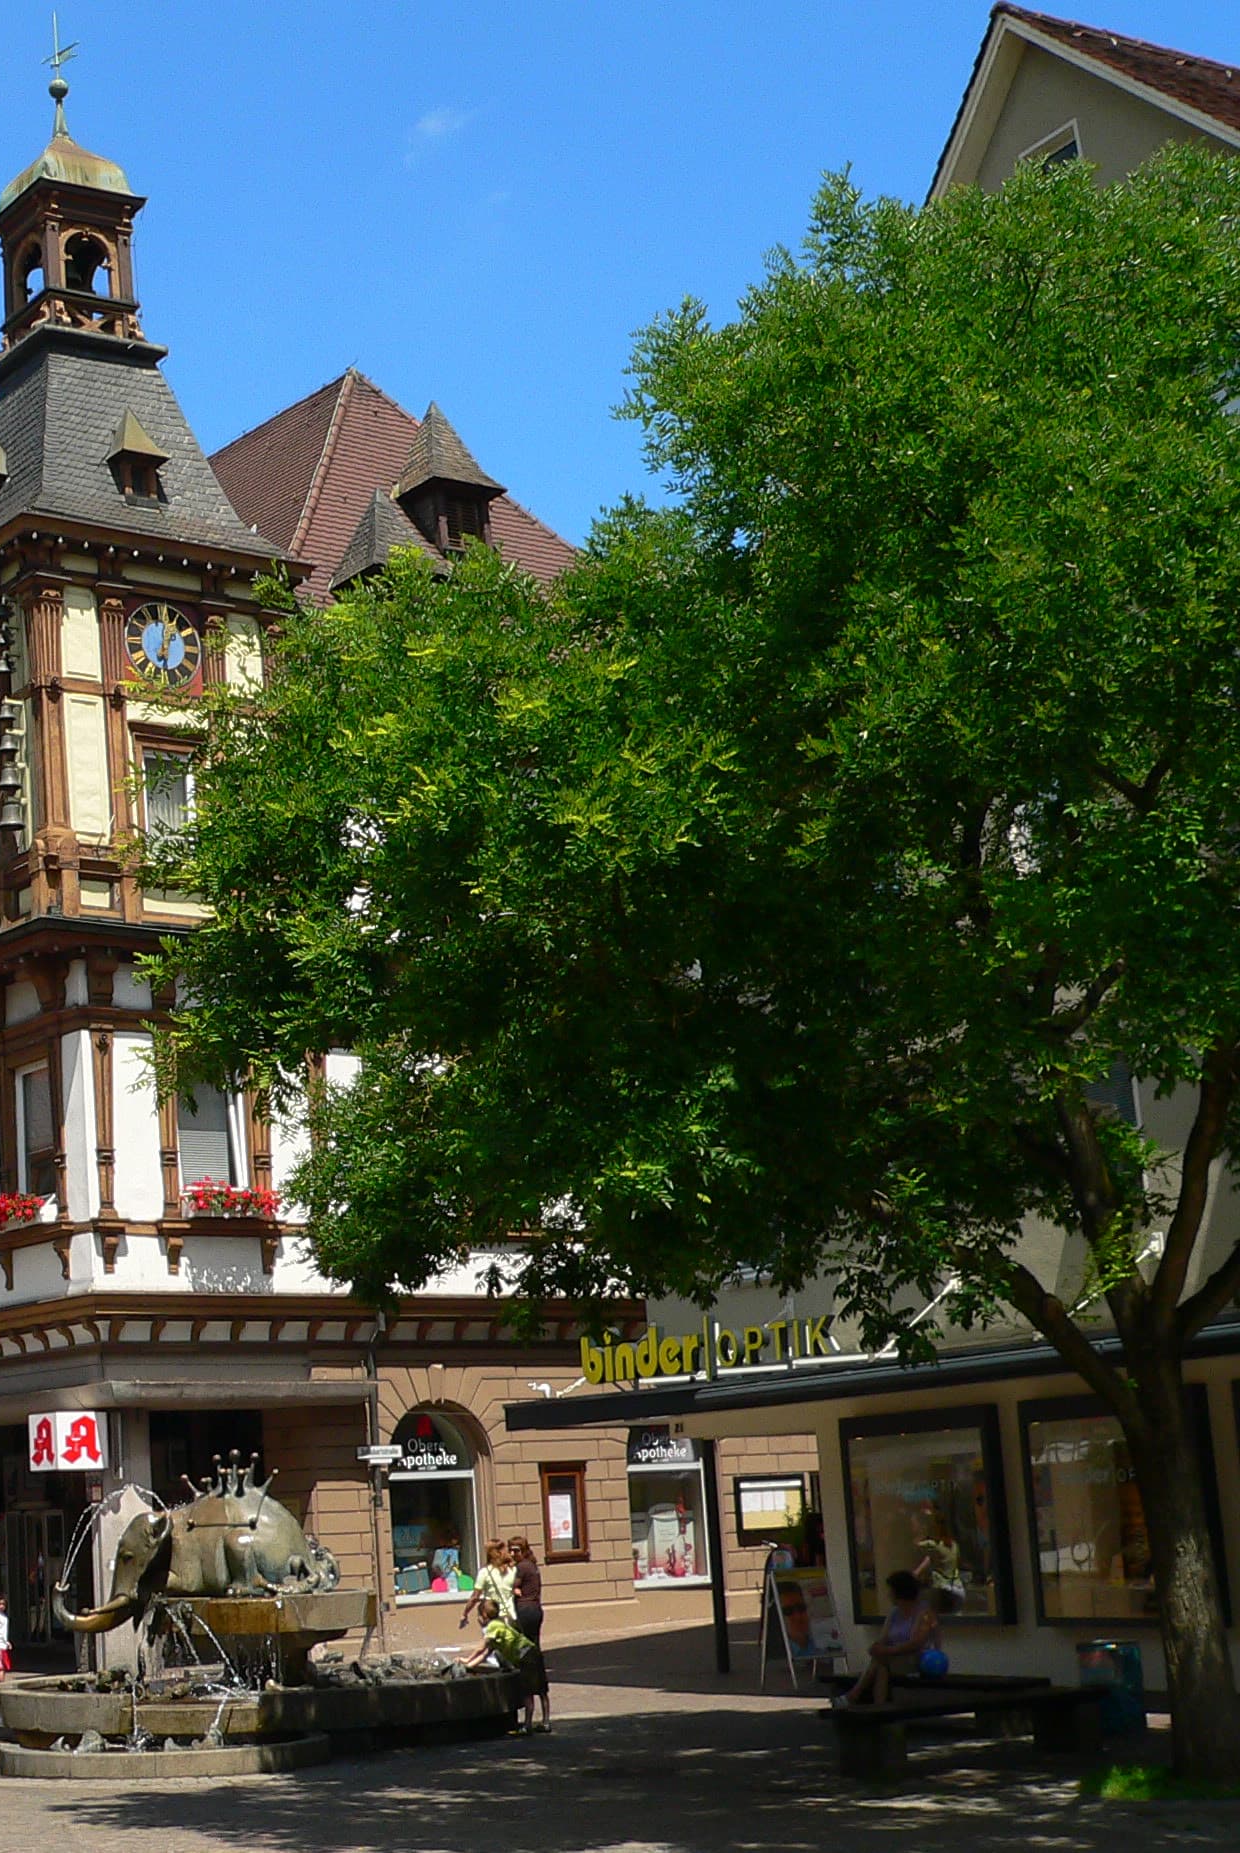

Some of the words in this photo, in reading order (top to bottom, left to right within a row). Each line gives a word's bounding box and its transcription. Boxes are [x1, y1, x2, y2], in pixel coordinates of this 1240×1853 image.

[580, 1324, 698, 1385] binder
[717, 1315, 832, 1366] OPTIK
[32, 1417, 55, 1467] A
[61, 1415, 101, 1464] A
[407, 1438, 445, 1453] Obere
